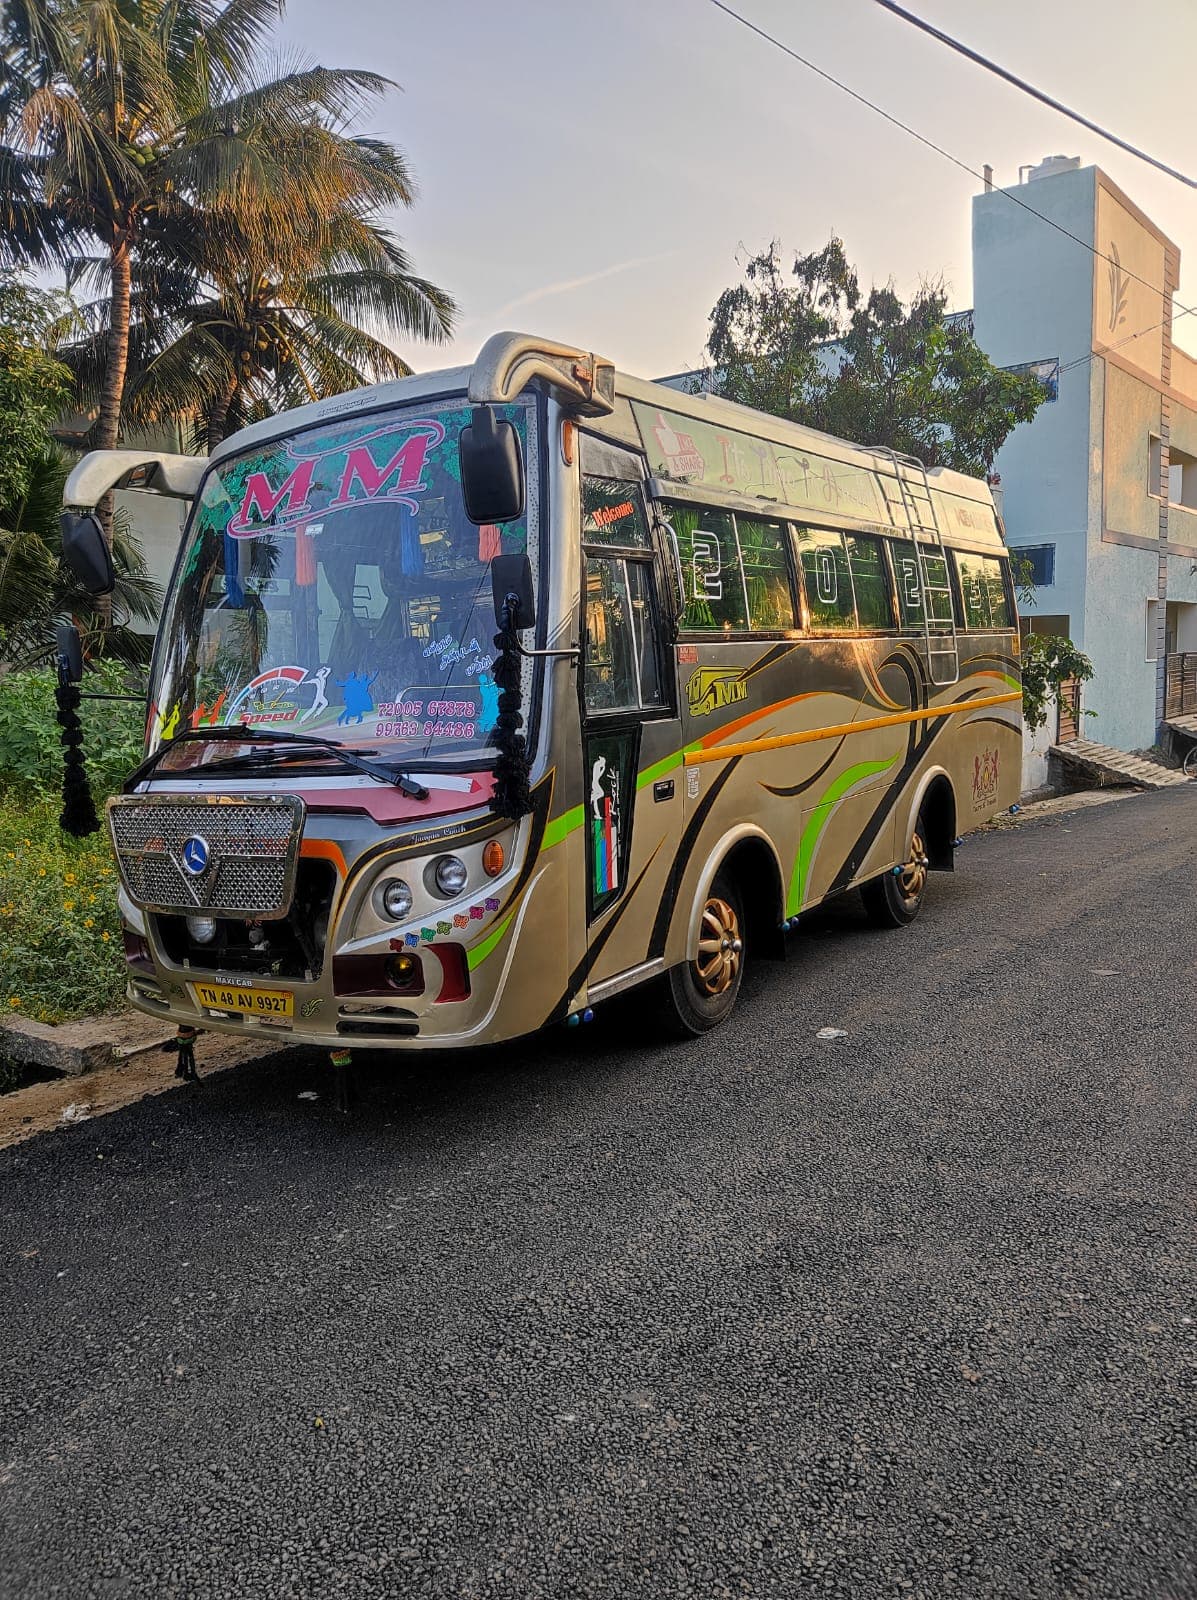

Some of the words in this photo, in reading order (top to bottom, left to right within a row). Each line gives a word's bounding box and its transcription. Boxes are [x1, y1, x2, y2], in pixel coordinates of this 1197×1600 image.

[592, 501, 634, 527] Welcome
[239, 708, 299, 725] Speed
[378, 701, 423, 717] 72005
[427, 701, 475, 717] 67878
[215, 976, 234, 985] MAXI
[236, 978, 253, 987] CAB
[200, 988, 217, 1003] TN
[220, 991, 234, 1006] 48
[238, 993, 253, 1008] AV
[256, 996, 287, 1012] 9927
